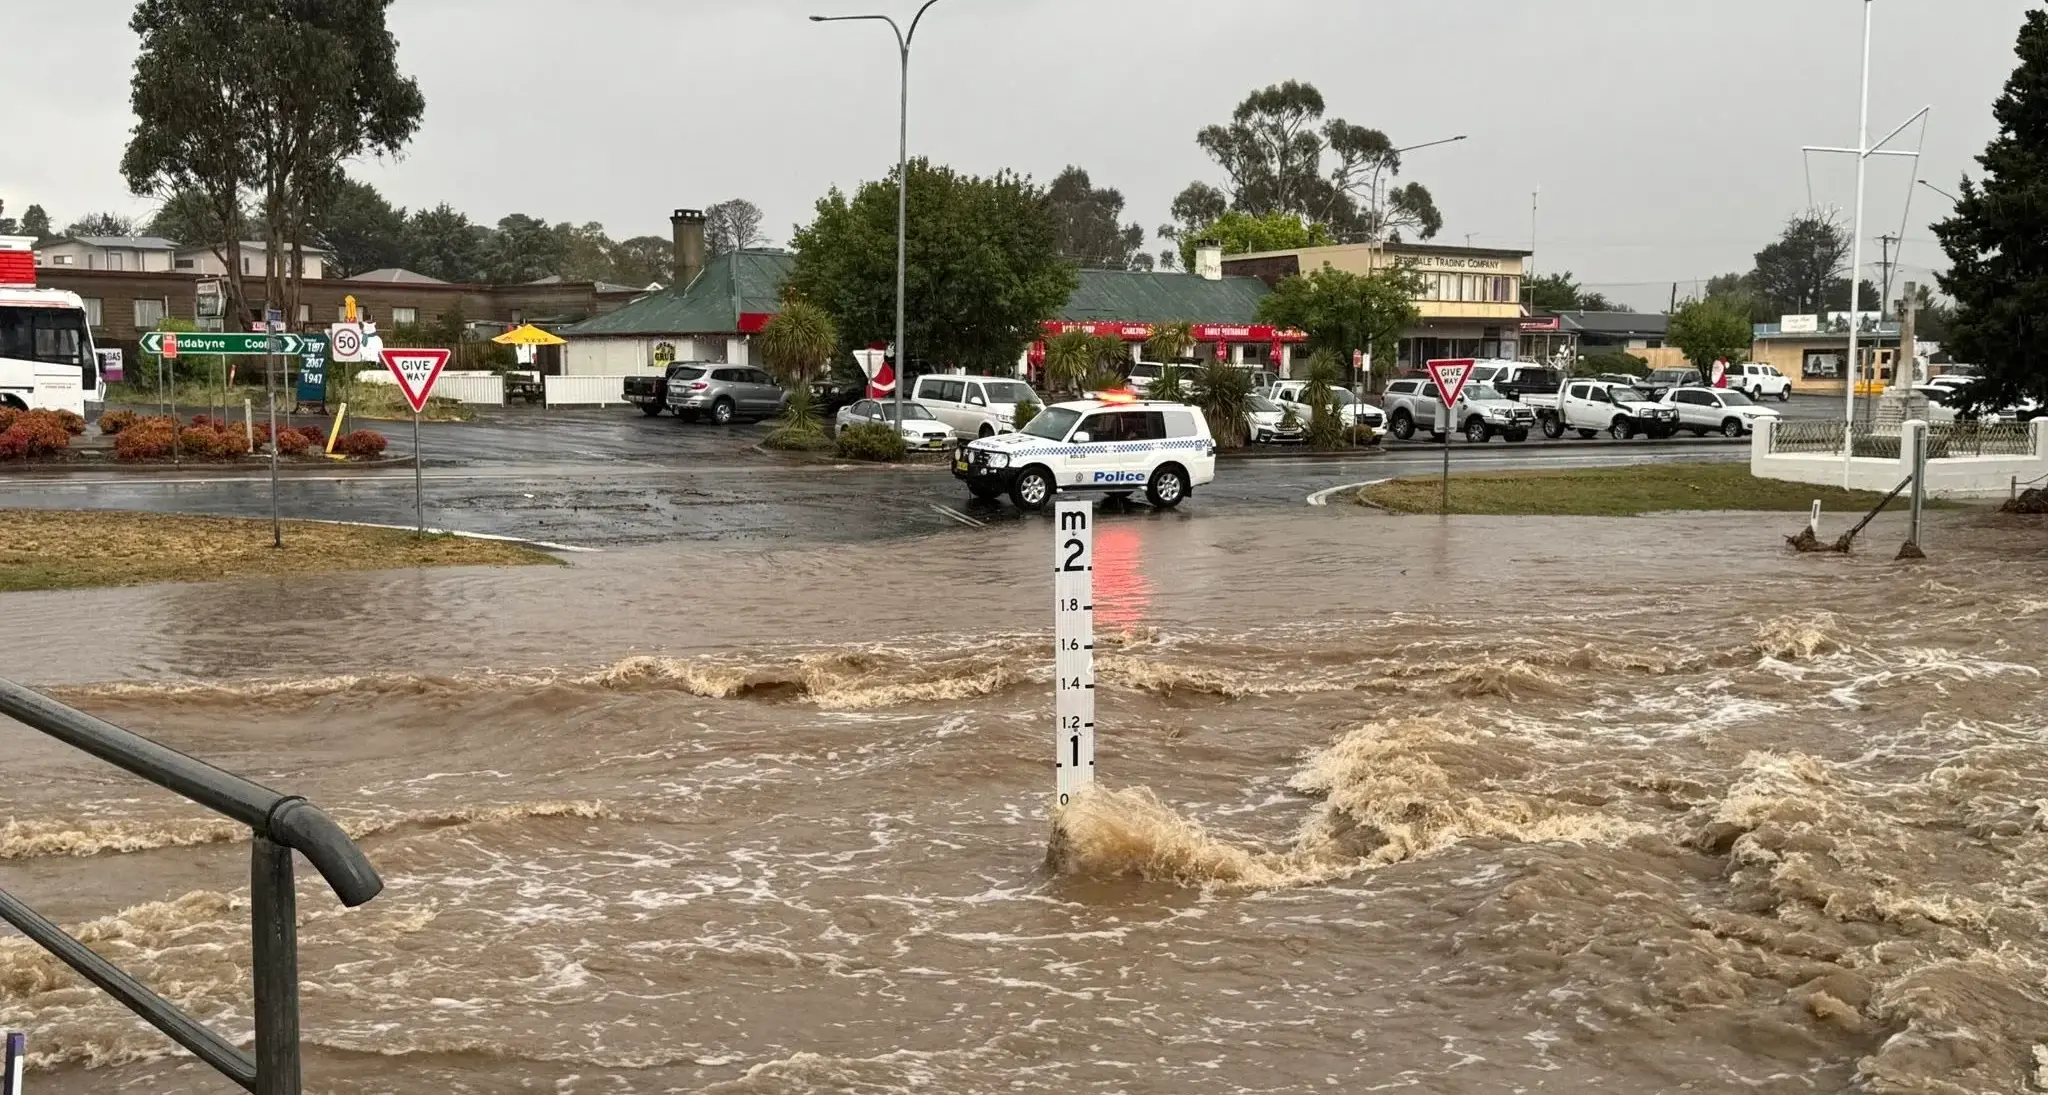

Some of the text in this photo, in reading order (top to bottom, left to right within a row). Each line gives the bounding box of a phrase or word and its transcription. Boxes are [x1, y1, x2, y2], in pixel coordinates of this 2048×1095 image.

[1435, 257, 1465, 268] TRADING
[1467, 259, 1499, 268] COMPANY
[177, 339, 225, 350] ndabyne
[338, 336, 356, 349] 50
[655, 352, 675, 361] GRUB
[401, 360, 431, 371] GIVE
[407, 372, 426, 381] WAY
[1441, 367, 1462, 377] GIVE
[304, 373, 323, 384] 1947
[1093, 471, 1145, 482] Police
[1062, 511, 1086, 530] m
[1064, 538, 1084, 572] 2
[1061, 598, 1078, 611] 1.8
[1061, 638, 1079, 651] 1.6
[1062, 676, 1080, 690] 1.4
[1062, 715, 1080, 729] 1.2
[1070, 735, 1078, 767] 1
